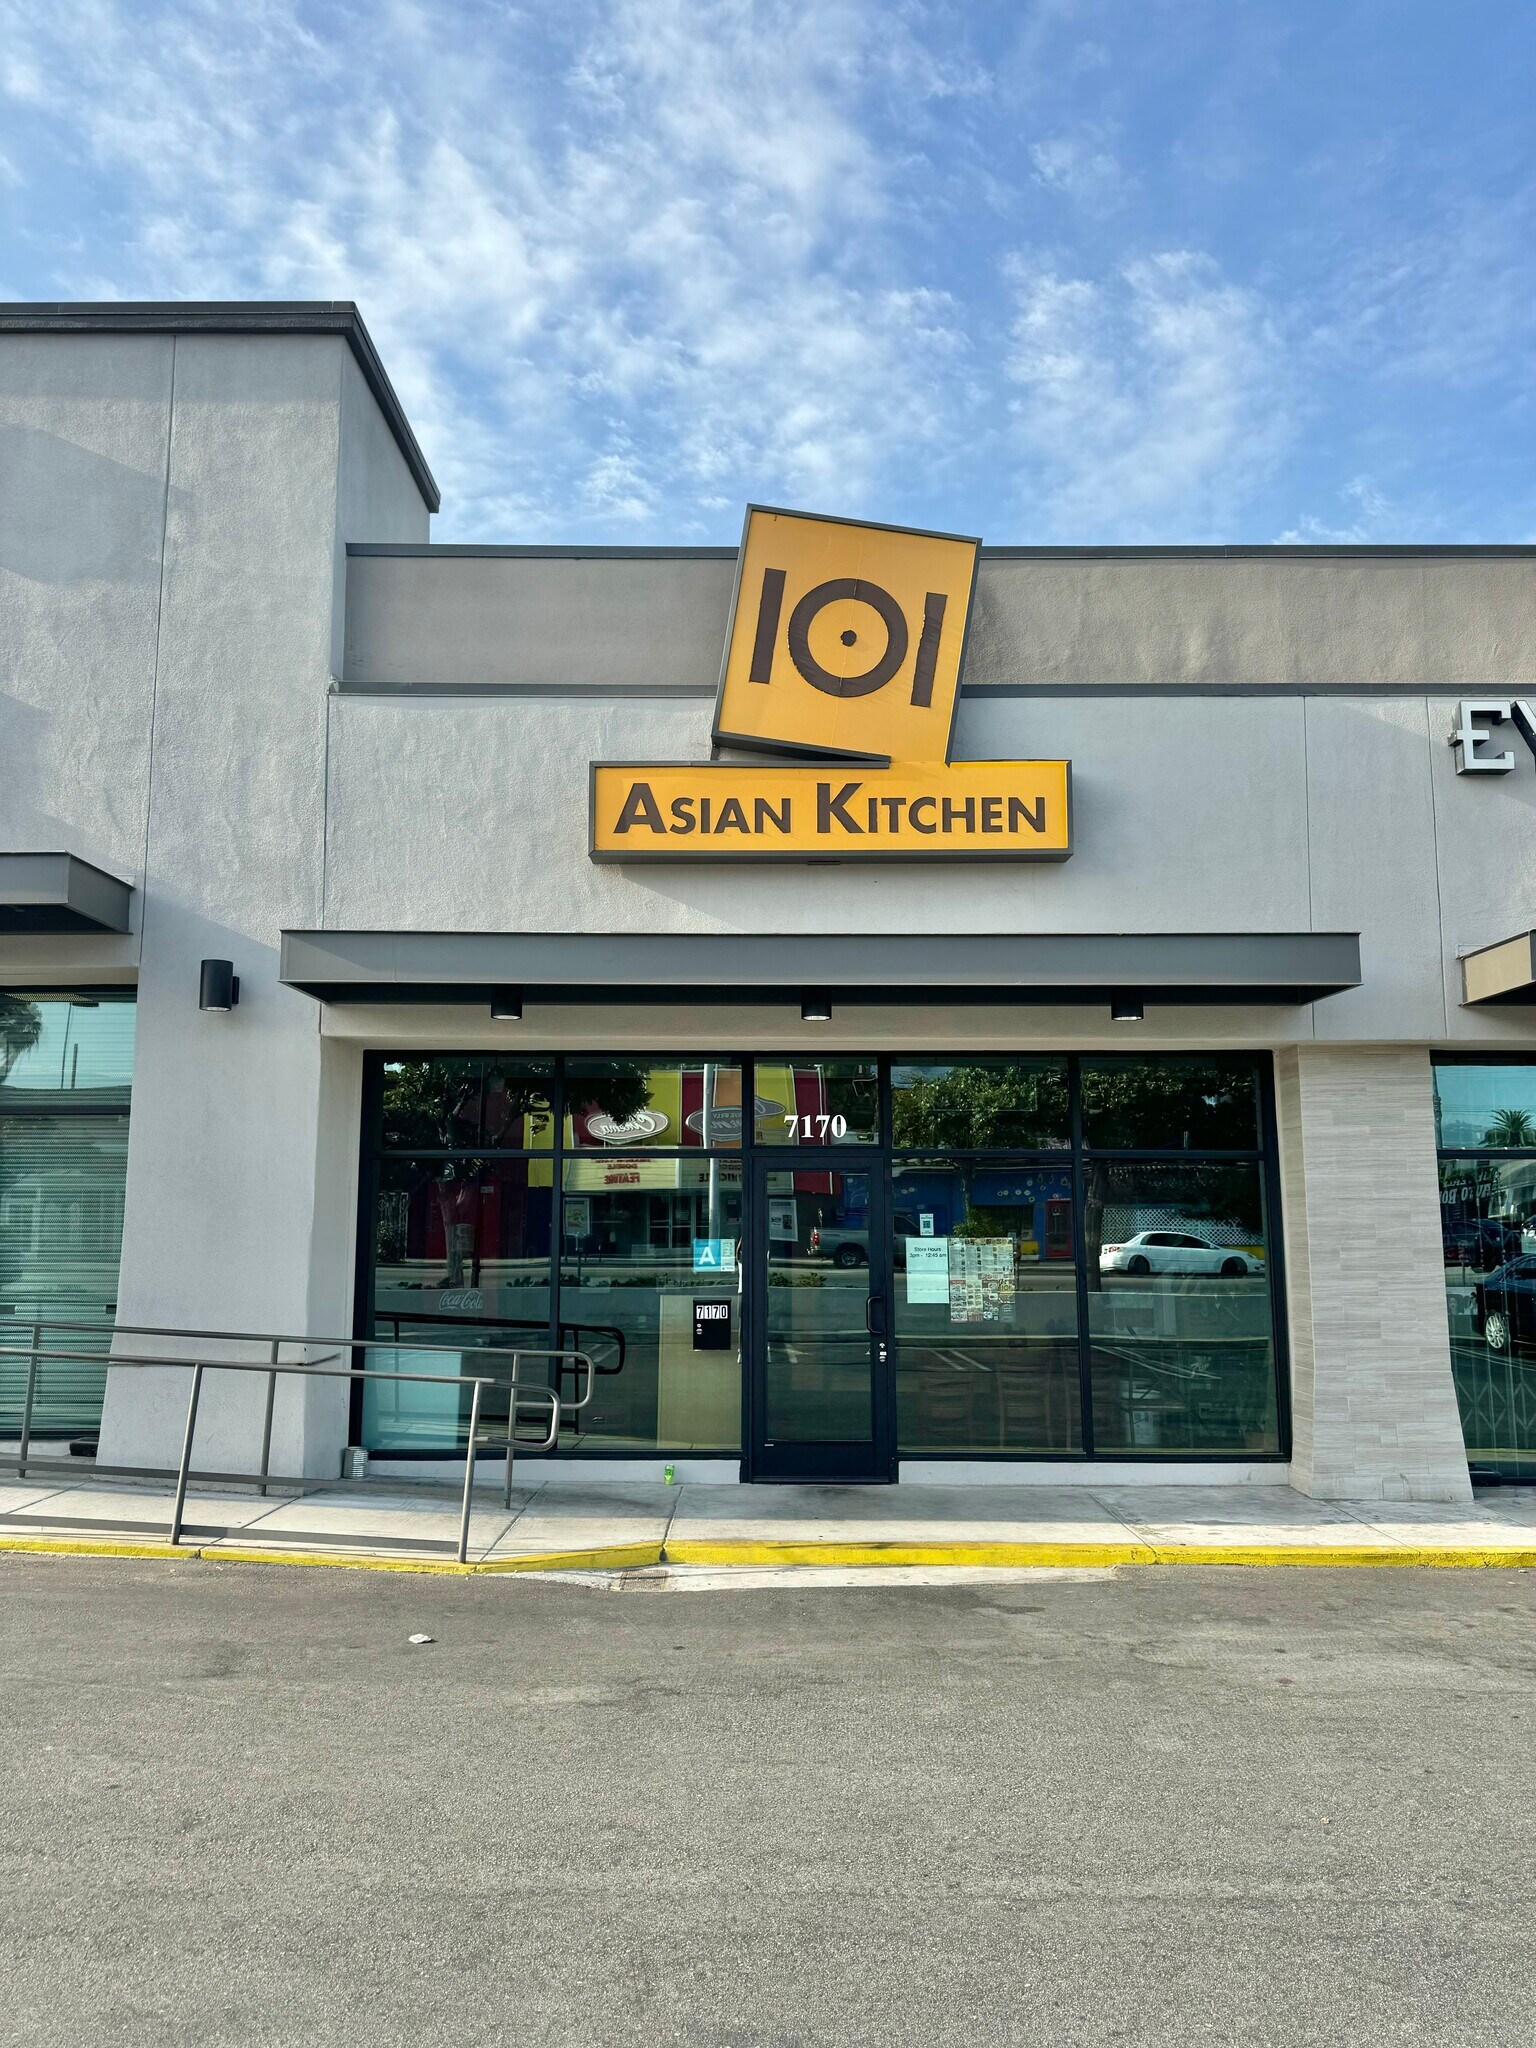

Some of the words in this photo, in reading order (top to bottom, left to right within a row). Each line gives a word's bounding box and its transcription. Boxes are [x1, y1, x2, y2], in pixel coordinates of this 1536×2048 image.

[748, 567, 948, 708] 101
[613, 782, 791, 835] ASIAN
[816, 782, 1046, 835] KITCHEN
[783, 1114, 847, 1138] 7170
[698, 1246, 716, 1265] A
[696, 1306, 728, 1318] 7170
